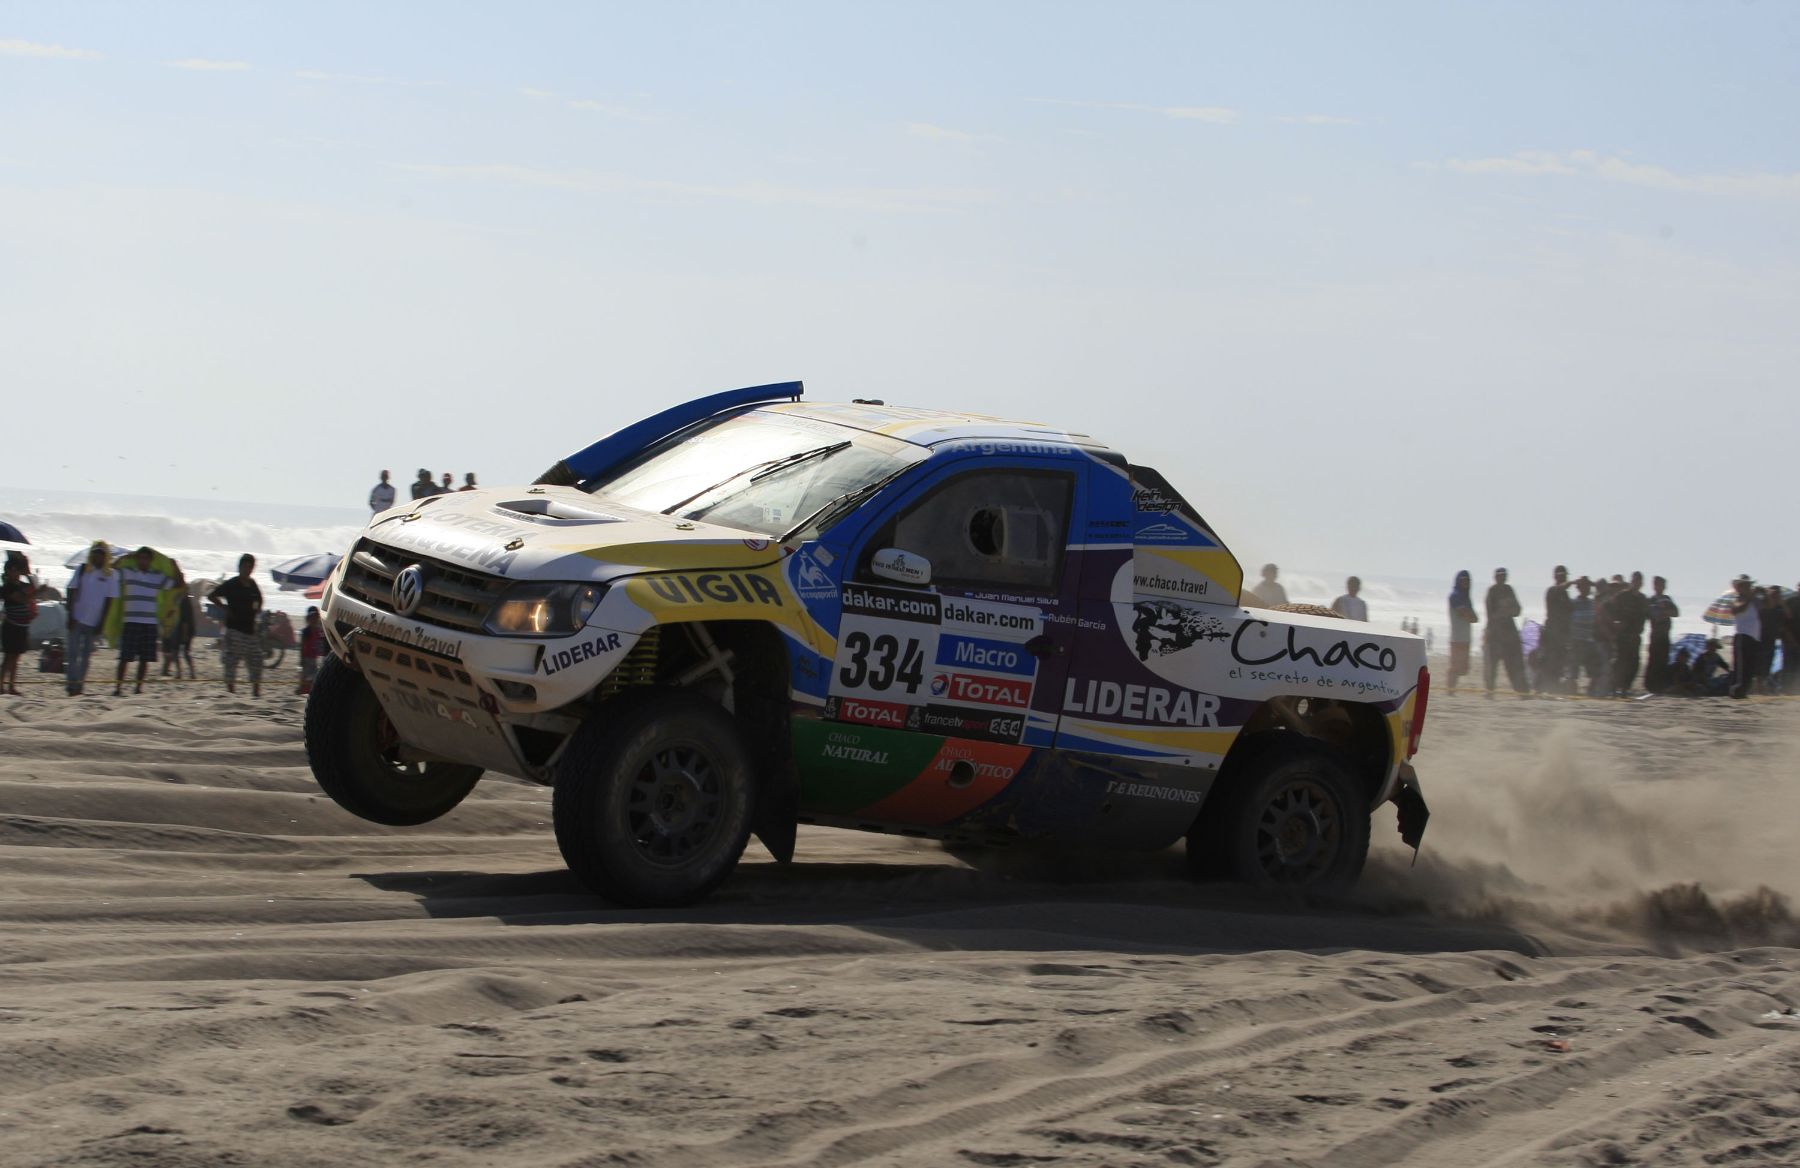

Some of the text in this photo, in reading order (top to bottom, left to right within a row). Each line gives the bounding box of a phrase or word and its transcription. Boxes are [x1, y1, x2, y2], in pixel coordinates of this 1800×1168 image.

[645, 573, 783, 606] VIGIA
[842, 589, 937, 617] dakar.com
[974, 593, 1059, 606] Juan Manuel Silva
[944, 603, 1034, 630] dakar.com
[1048, 613, 1077, 625] Rubén
[542, 633, 622, 676] LIDERAR
[955, 641, 1018, 668] Macro
[1231, 619, 1396, 671] Chaco
[840, 631, 924, 694] 334
[954, 677, 1026, 705] TOTAL
[1229, 668, 1242, 679] el
[1251, 670, 1309, 684] secreto
[1317, 675, 1334, 687] de
[845, 701, 902, 722] TOTAL
[1063, 677, 1221, 728] LIDERAR
[828, 732, 861, 745] CHACO
[821, 744, 889, 765] NATURAL
[1126, 782, 1202, 803] REUNIONES
